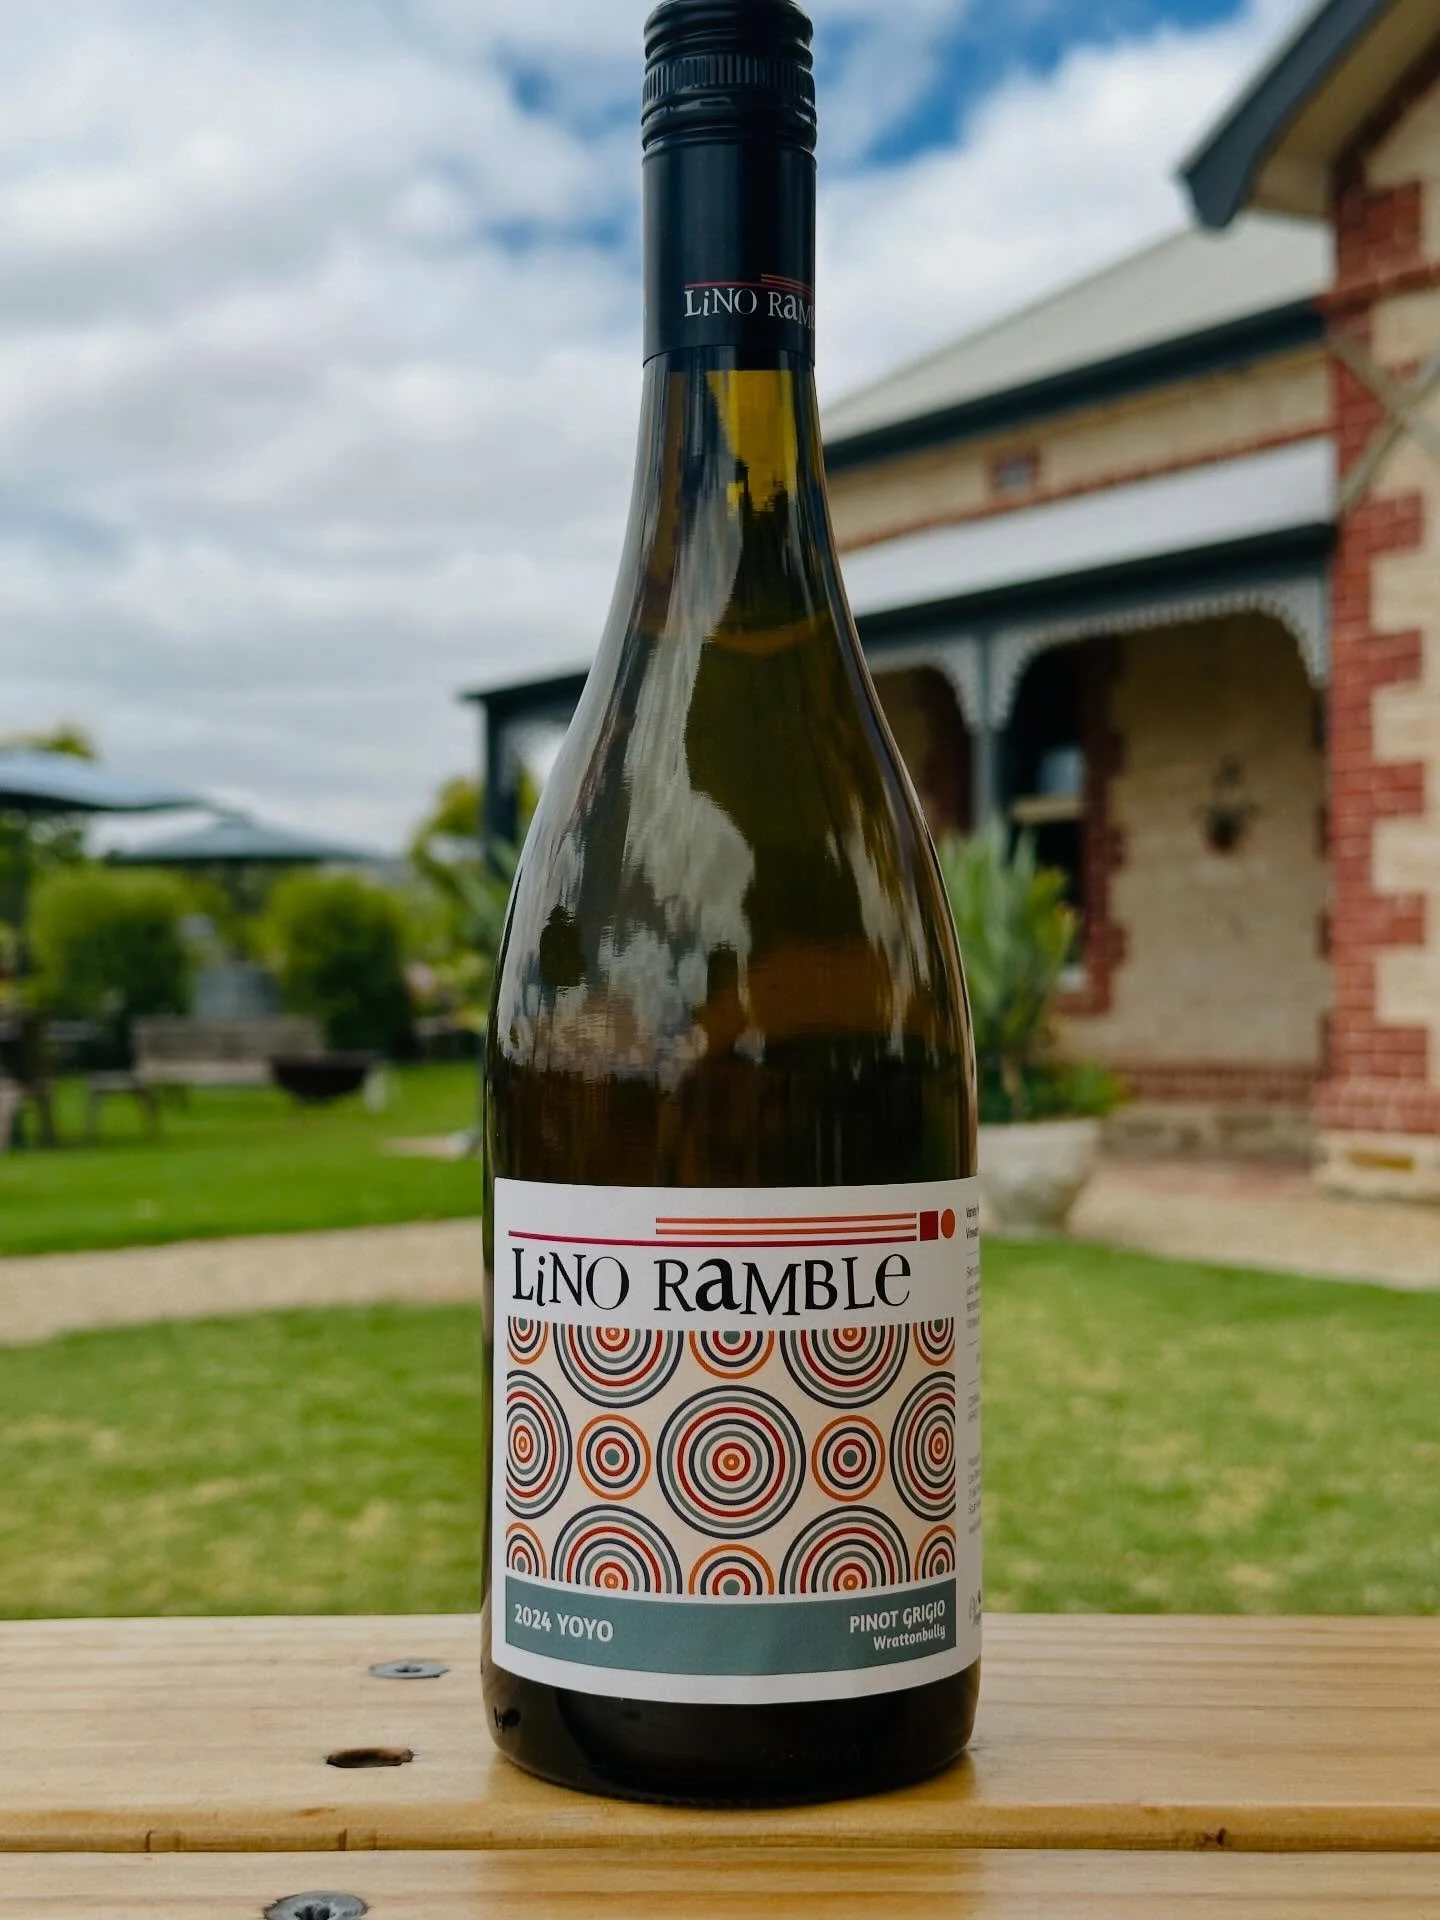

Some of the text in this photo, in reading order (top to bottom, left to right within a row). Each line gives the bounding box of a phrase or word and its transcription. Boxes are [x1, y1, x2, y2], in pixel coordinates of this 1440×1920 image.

[684, 288, 757, 316] LiNO
[512, 1247, 630, 1311] LiNO
[514, 1603, 614, 1643] 2024 YOYO
[849, 1610, 898, 1634] PINOT
[902, 1599, 946, 1630] GRIGIO
[873, 1623, 946, 1651] Wrattonbully
